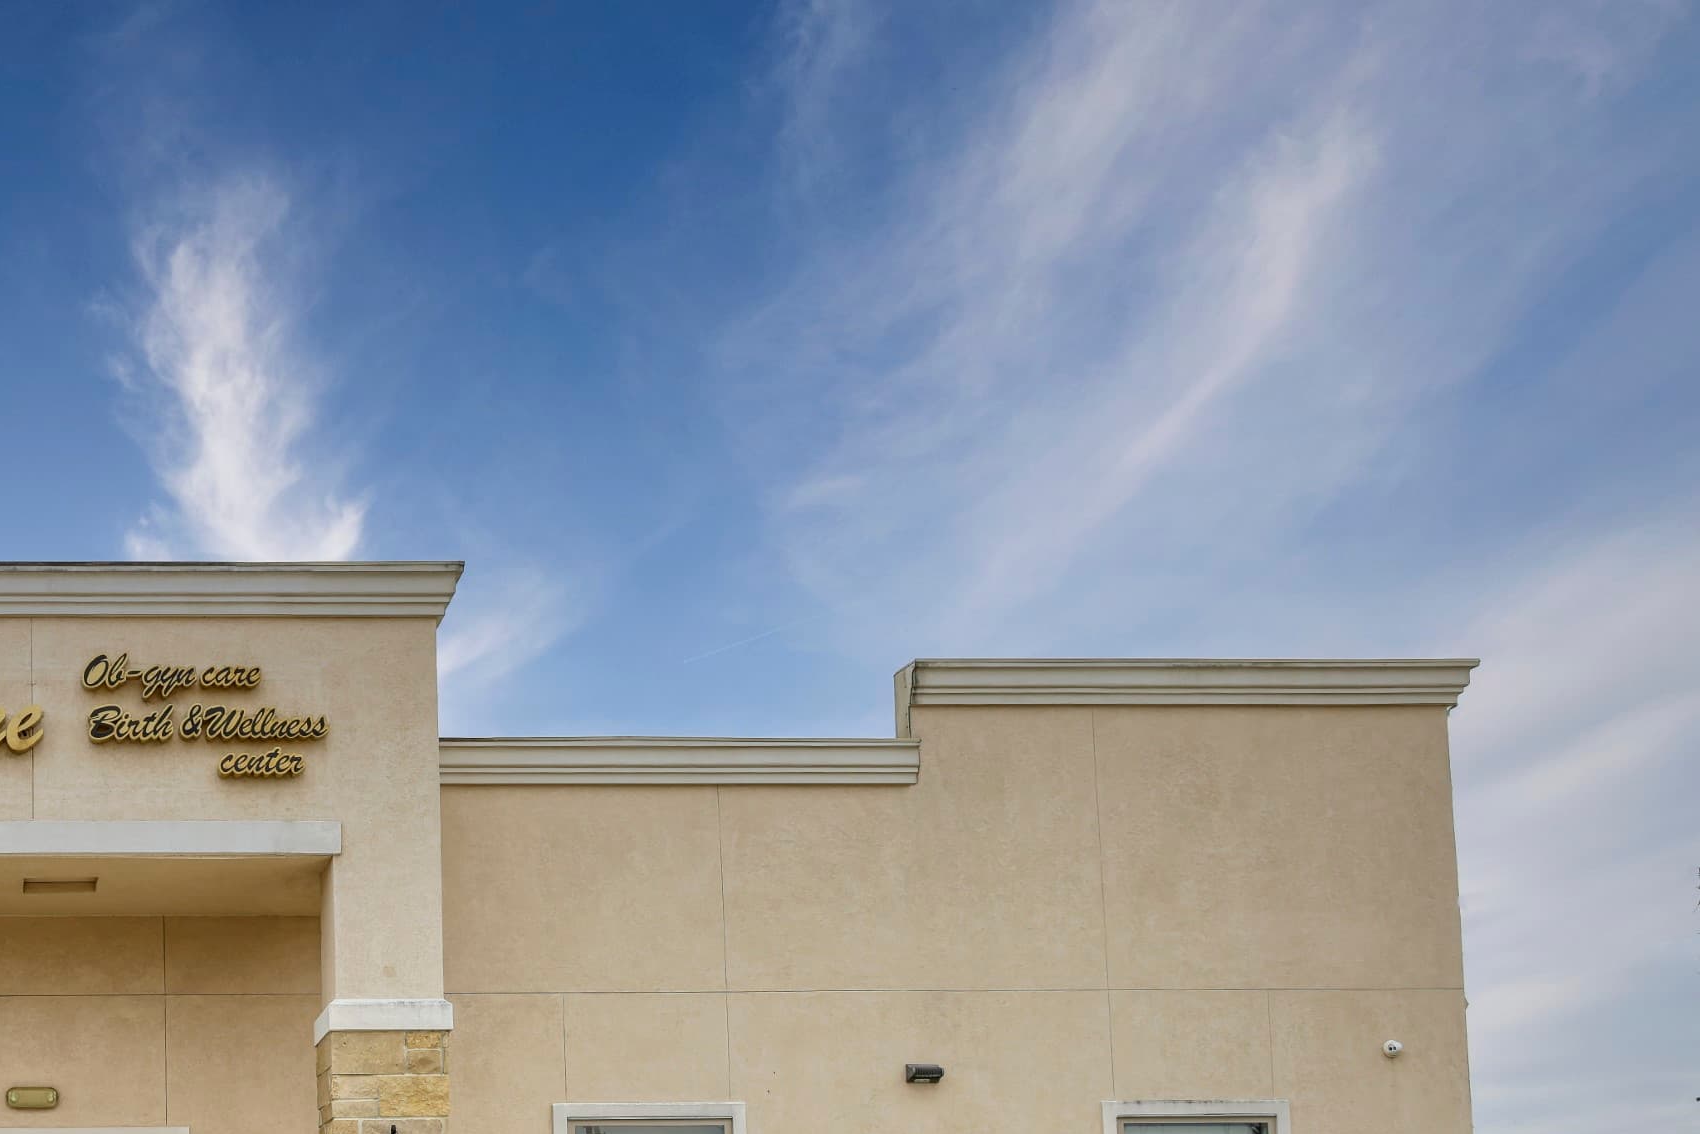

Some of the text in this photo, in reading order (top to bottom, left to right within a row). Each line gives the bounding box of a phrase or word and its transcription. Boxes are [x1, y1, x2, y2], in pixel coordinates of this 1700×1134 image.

[83, 652, 262, 699] Ob-gyn care
[89, 702, 329, 743] Birth & Wellness
[218, 746, 306, 777] center
